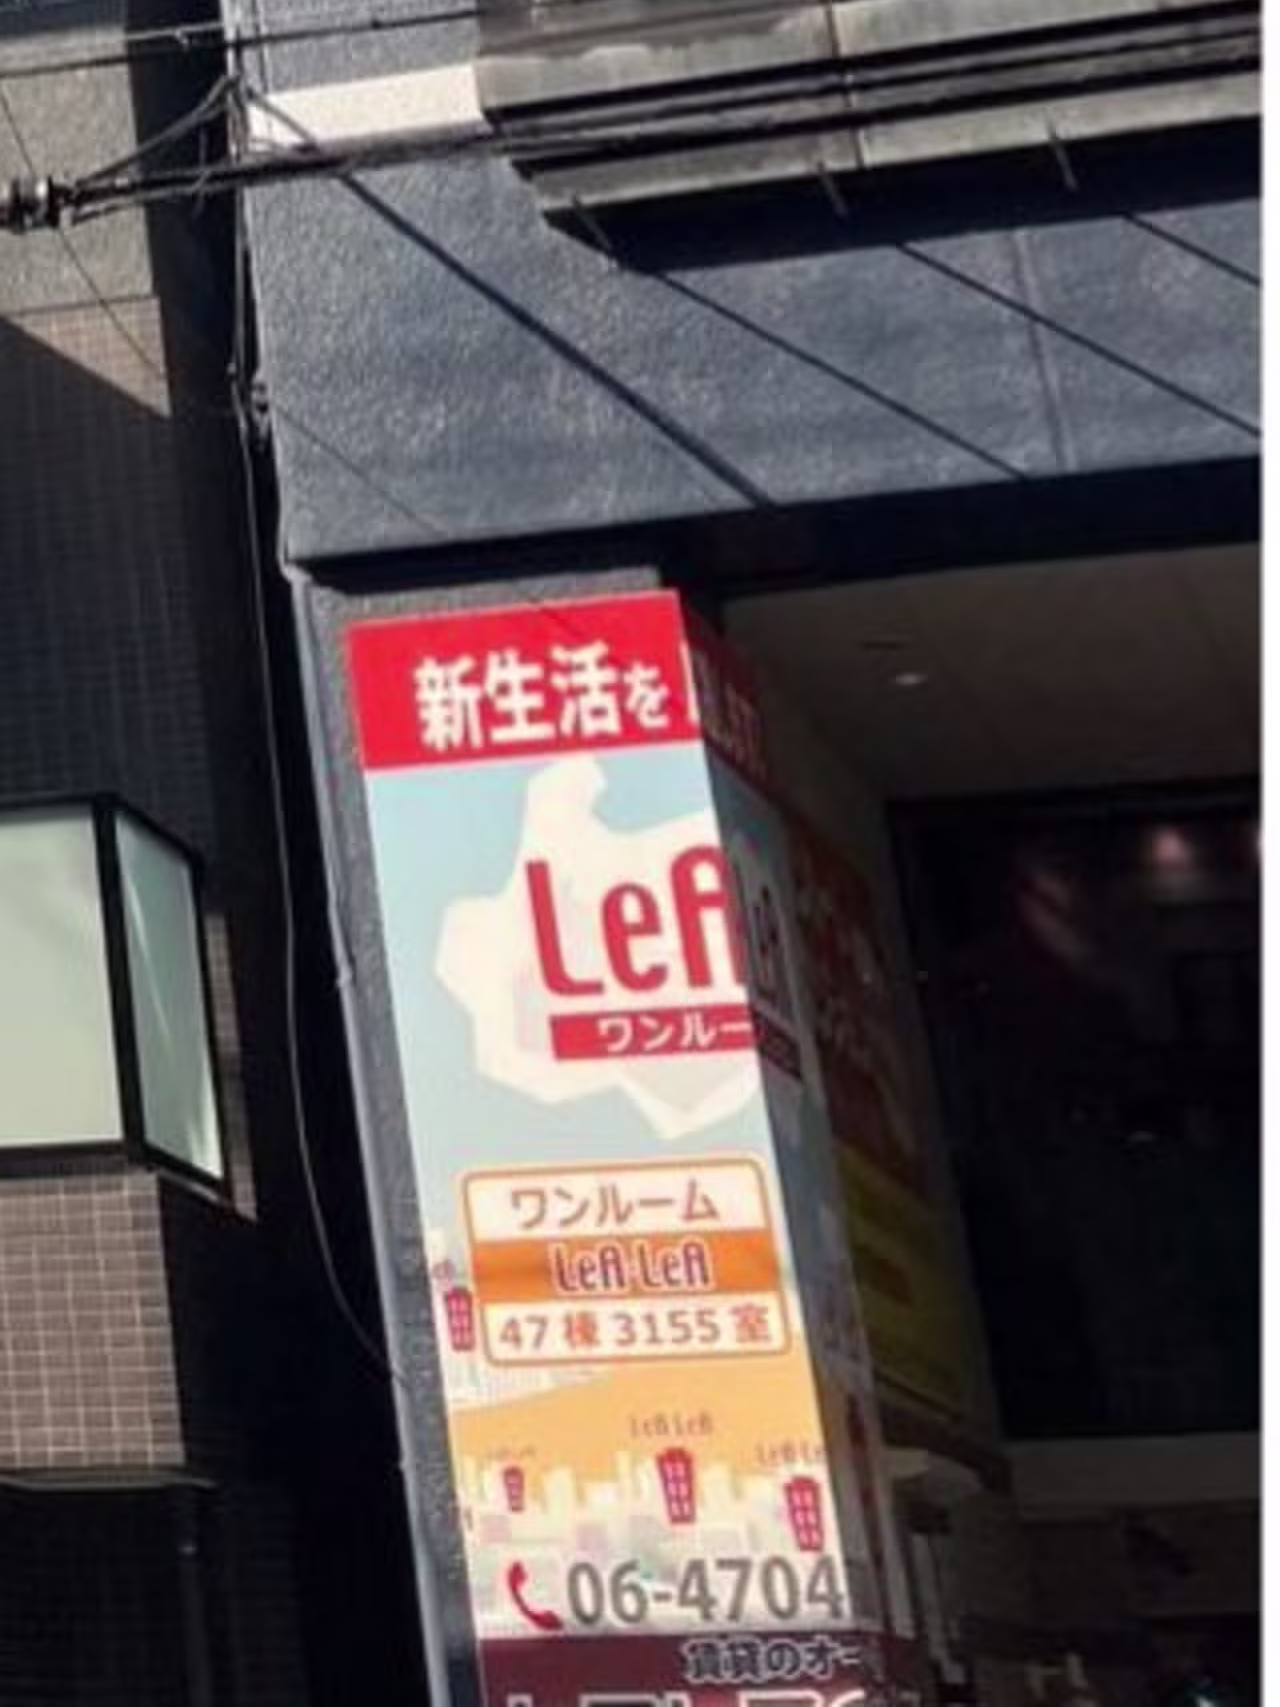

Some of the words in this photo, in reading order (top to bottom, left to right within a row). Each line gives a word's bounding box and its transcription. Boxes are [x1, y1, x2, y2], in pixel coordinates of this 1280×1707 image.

[510, 1179, 720, 1230] ワンルーム
[566, 1554, 845, 1626] 06-4704
